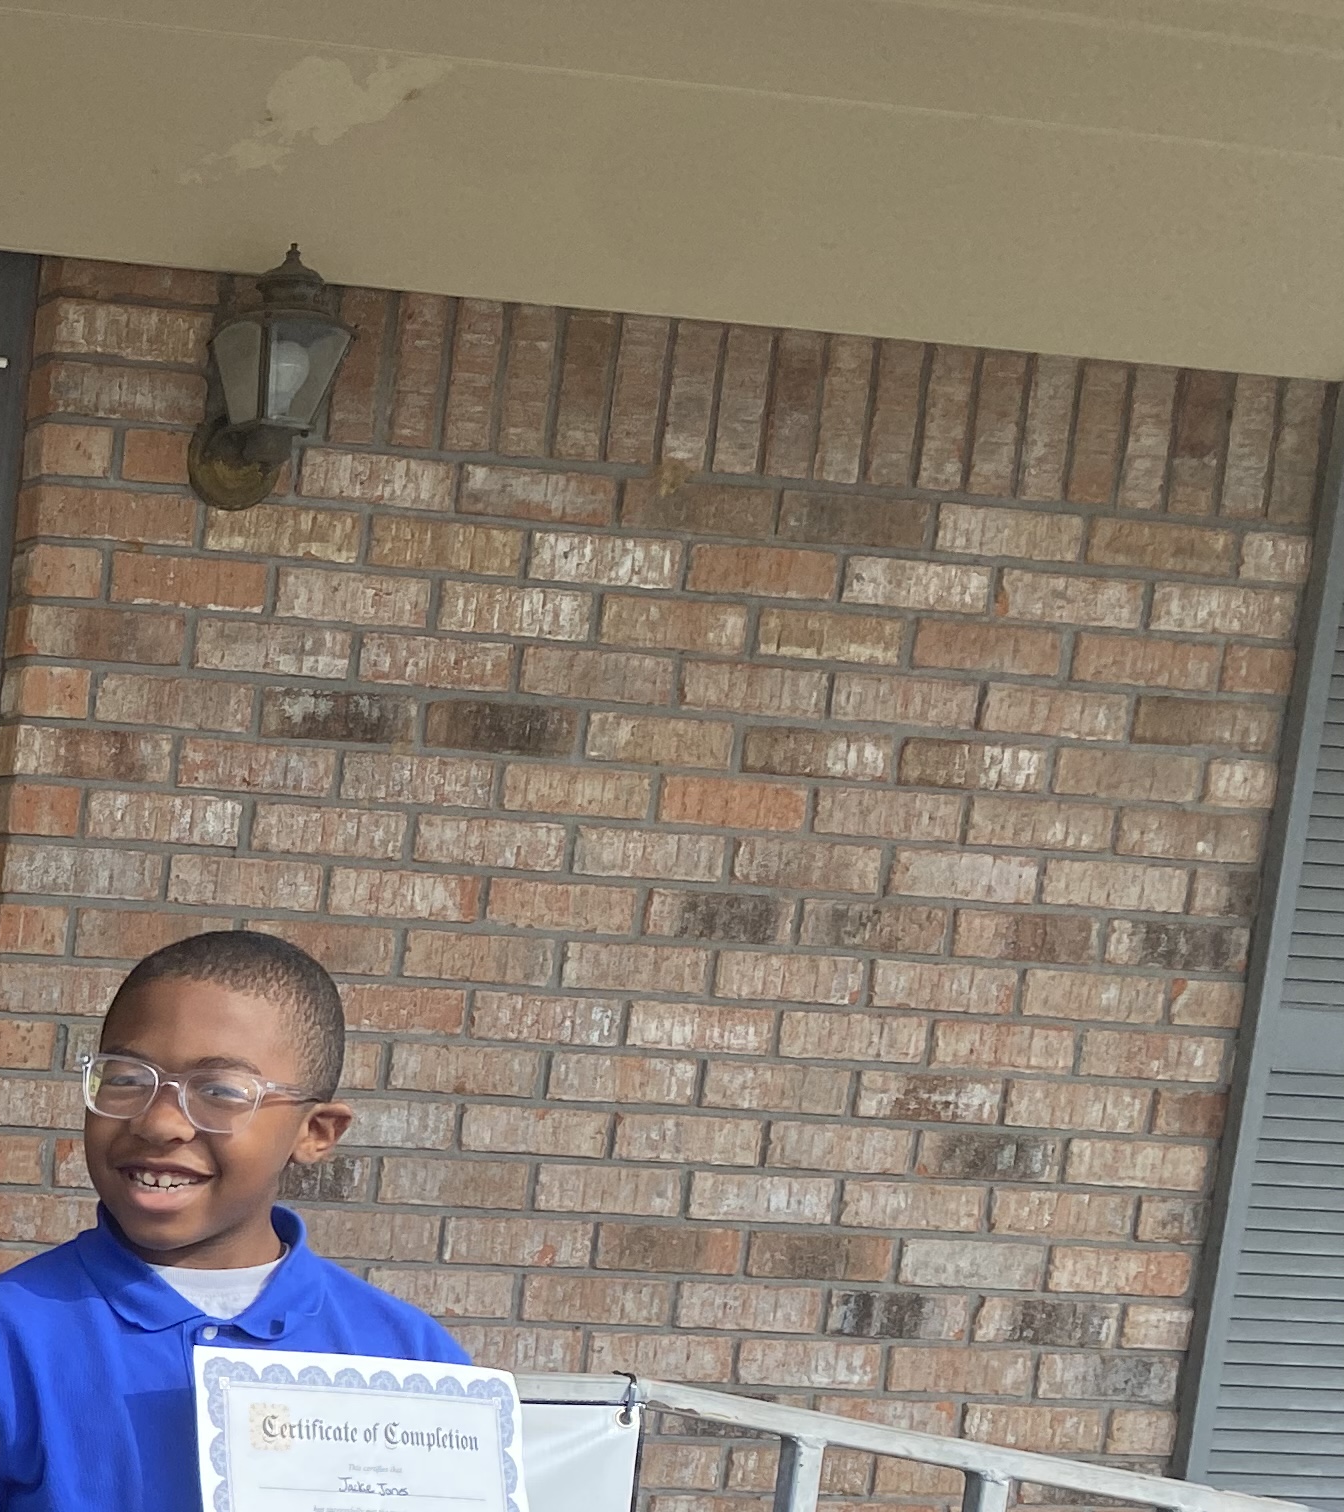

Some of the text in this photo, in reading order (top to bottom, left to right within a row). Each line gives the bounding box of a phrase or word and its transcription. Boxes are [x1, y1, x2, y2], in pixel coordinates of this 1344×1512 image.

[262, 1415, 479, 1452] Certificate of Completion
